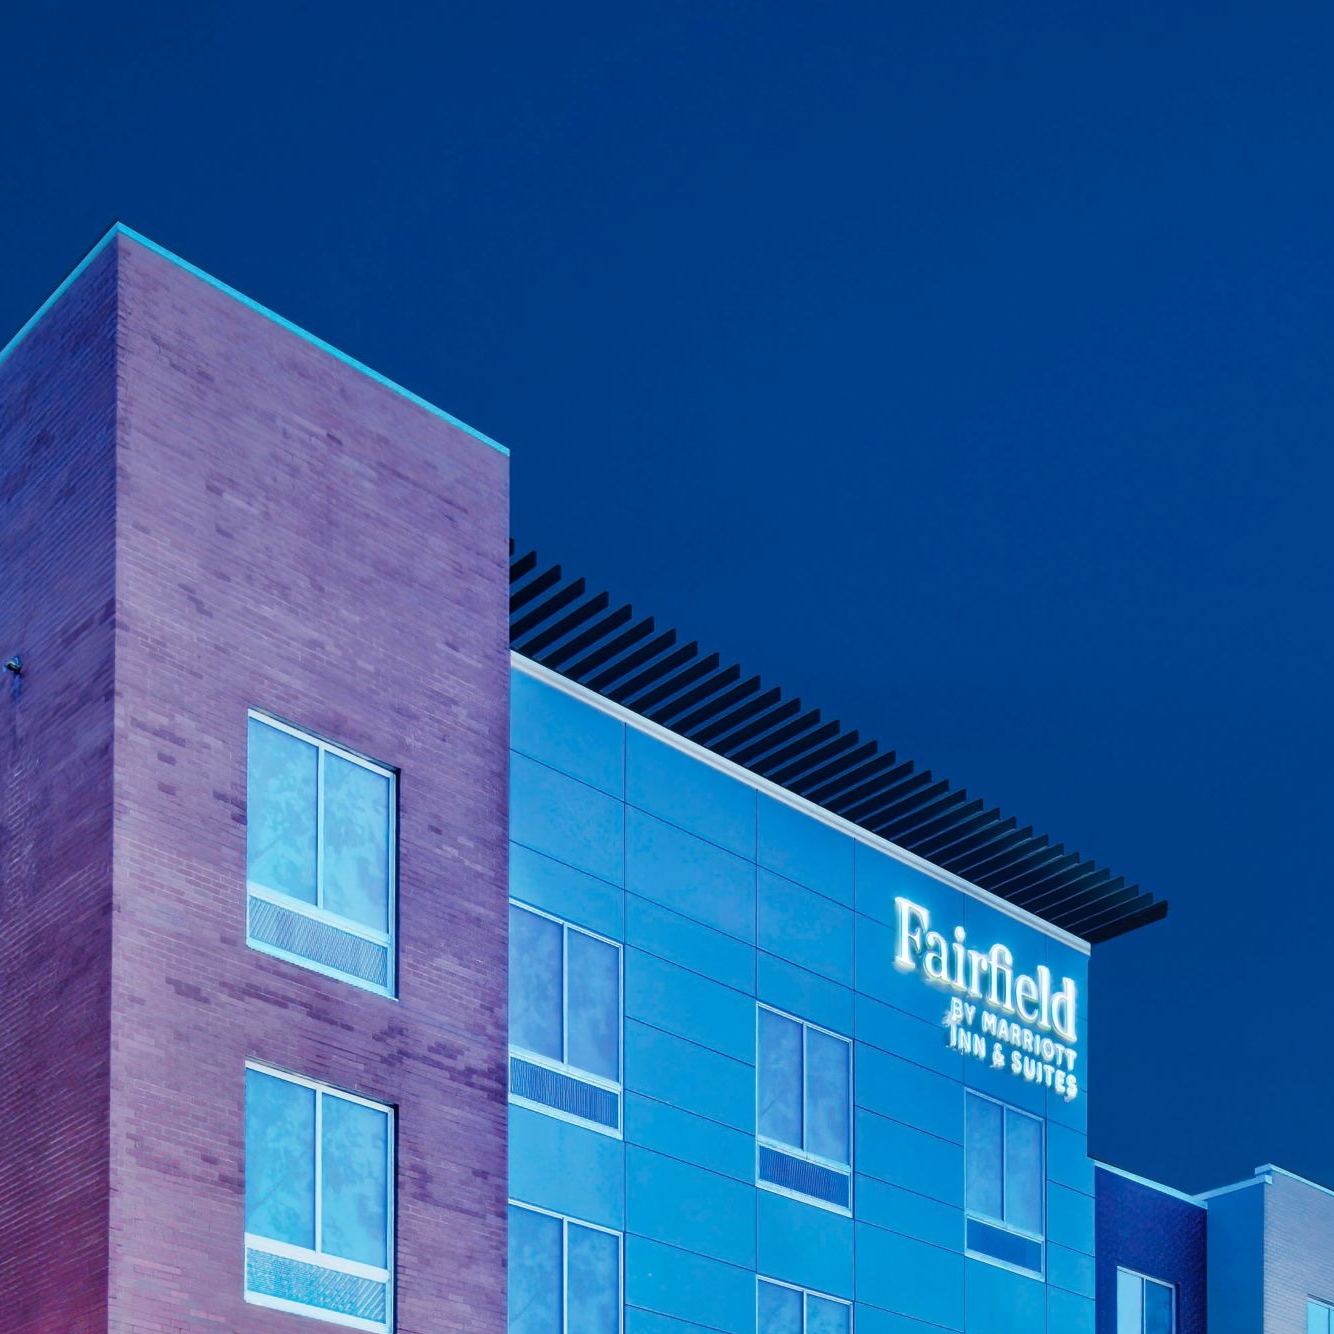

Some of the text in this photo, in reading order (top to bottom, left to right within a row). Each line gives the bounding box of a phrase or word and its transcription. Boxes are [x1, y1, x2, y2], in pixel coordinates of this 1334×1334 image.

[893, 896, 1078, 1044] Fairfield
[948, 1022, 1078, 1100] INN & SUITES
[950, 997, 1078, 1071] BY MARRIOTT
